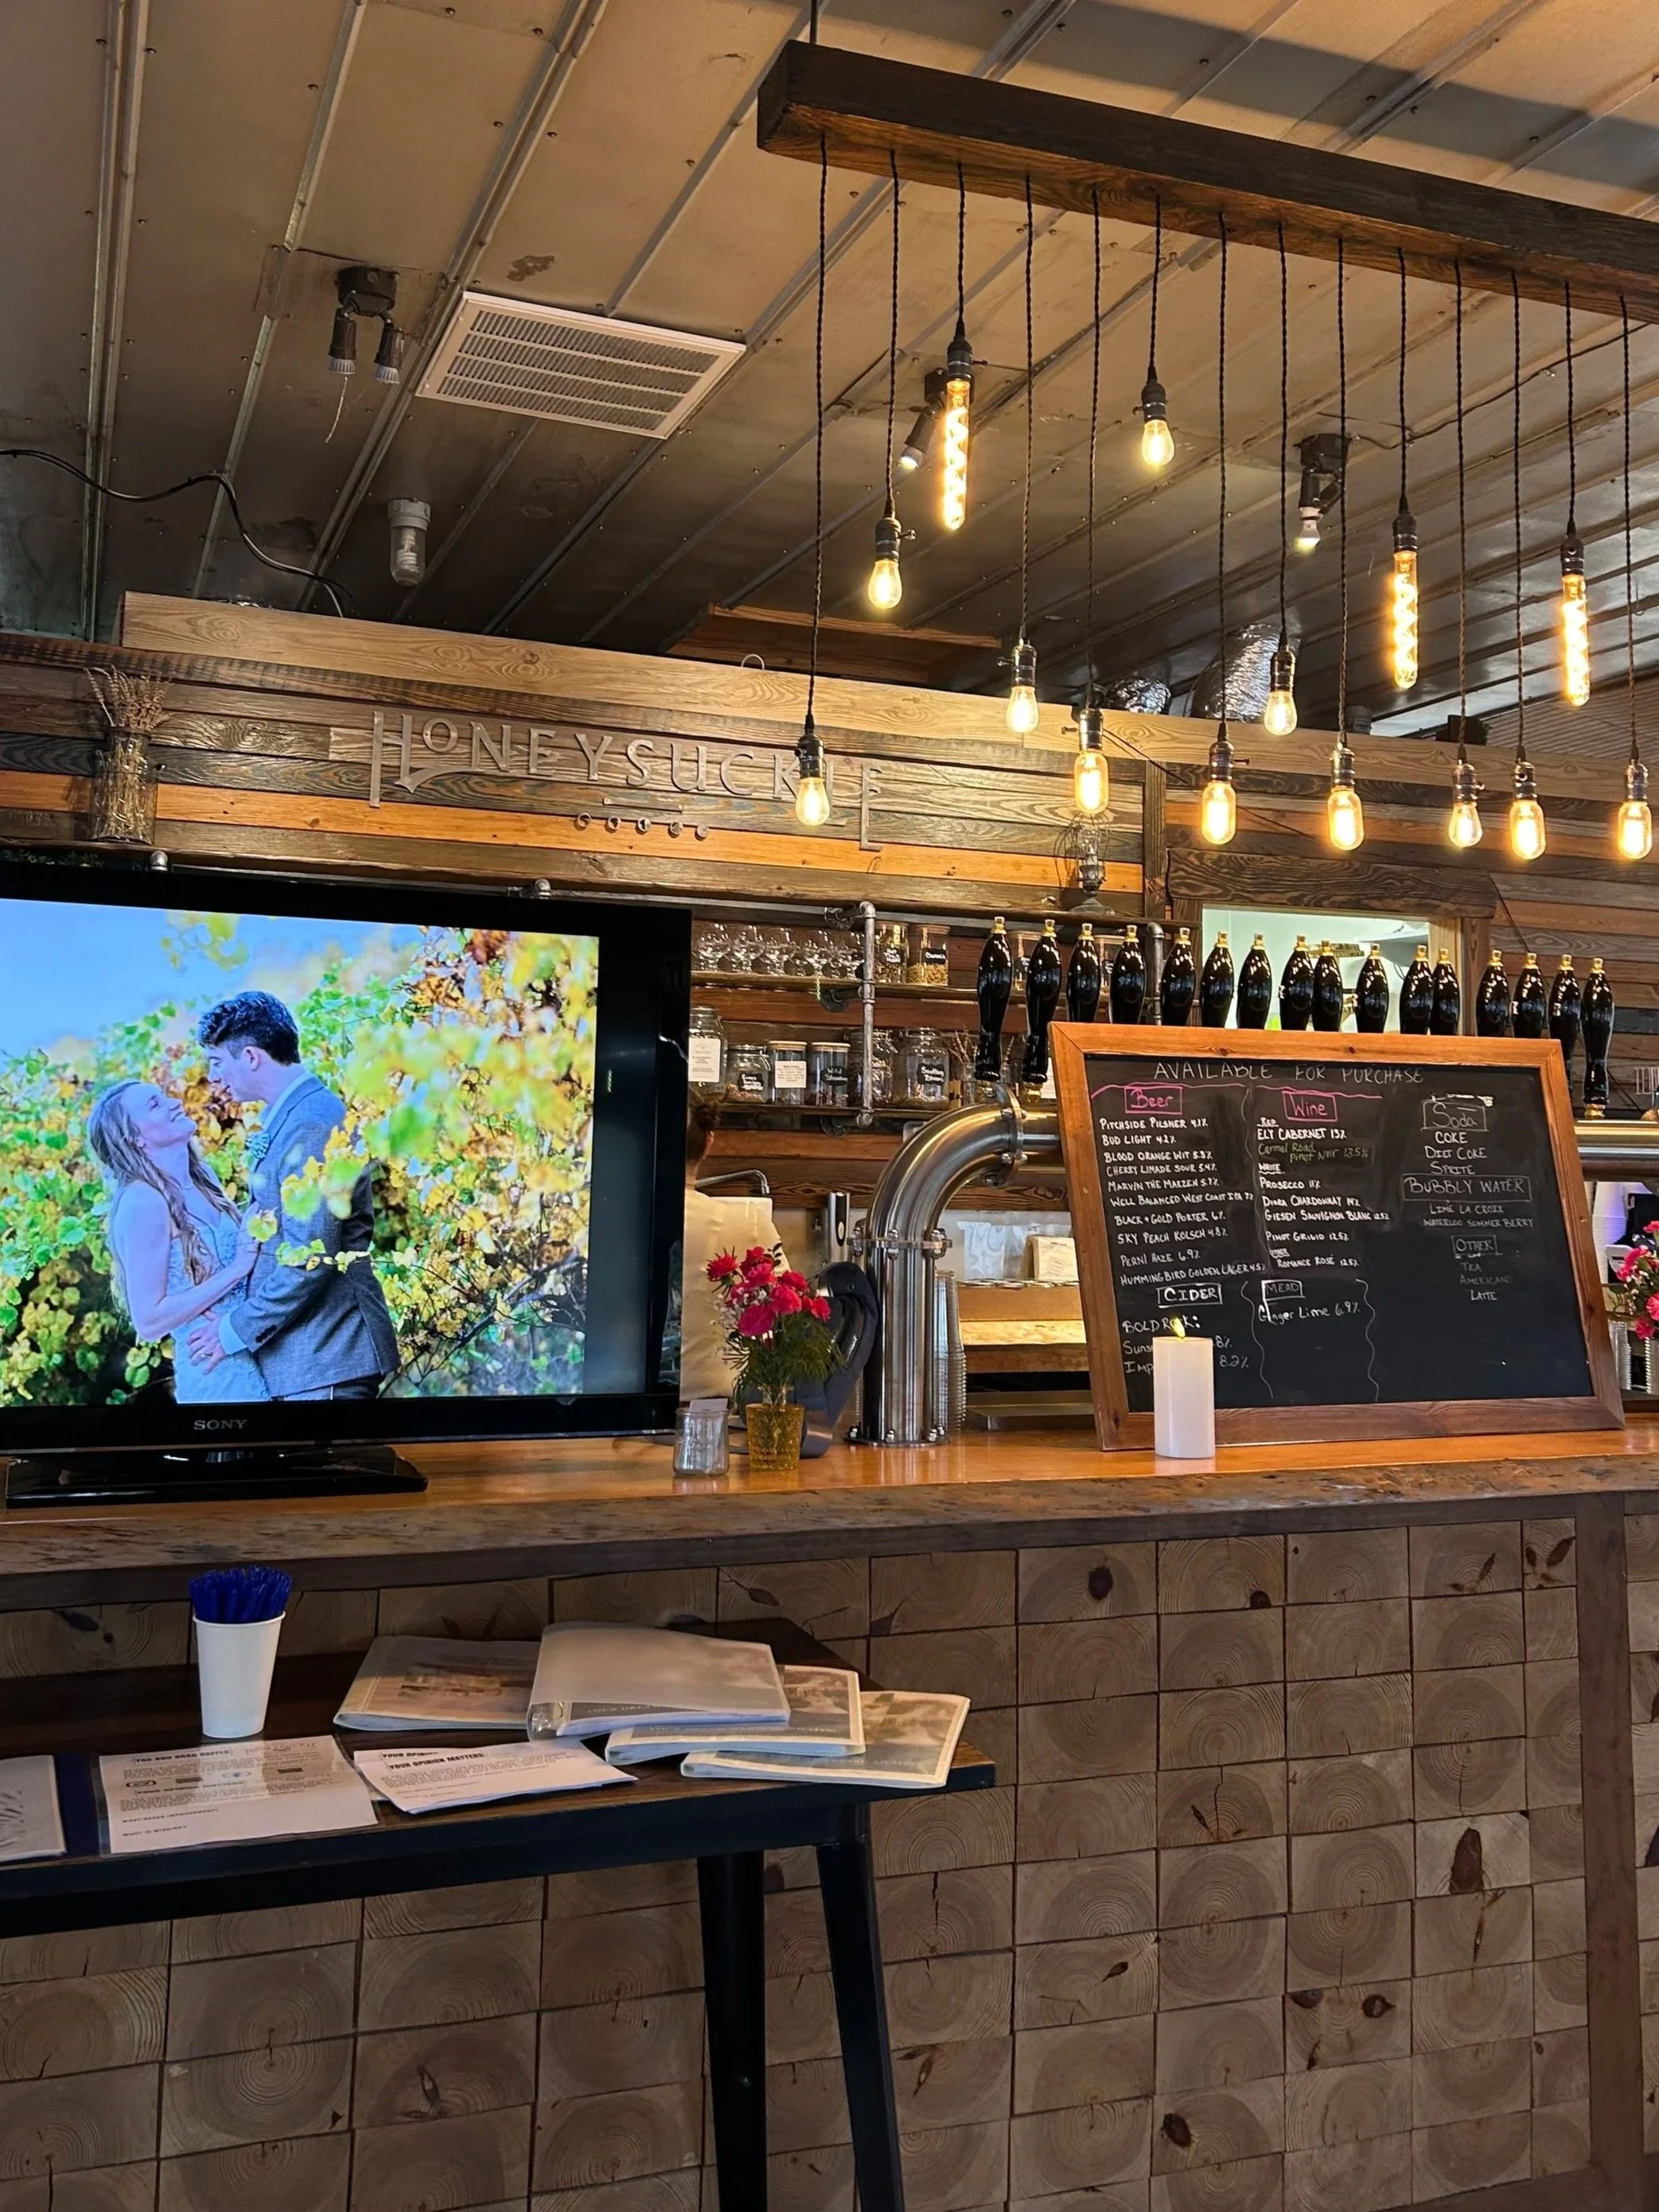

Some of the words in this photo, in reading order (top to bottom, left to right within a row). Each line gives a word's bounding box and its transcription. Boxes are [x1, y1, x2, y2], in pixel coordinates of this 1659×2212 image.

[1154, 1062, 1273, 1081] AVAILABLE
[1295, 1063, 1326, 1081] FOR
[1342, 1066, 1425, 1085] PURCHASE
[1130, 1087, 1174, 1108] Beer
[1289, 1093, 1328, 1117] Wine
[1432, 1101, 1478, 1128] Soda
[1099, 1117, 1147, 1130] PITCHSIDE
[1149, 1116, 1187, 1129] PILSNER
[1101, 1133, 1121, 1147] BUD
[1124, 1134, 1152, 1146] LIGHT
[1257, 1128, 1274, 1140] ELY
[1278, 1127, 1328, 1140] CABERNET
[1435, 1131, 1469, 1144] COKE
[1291, 1141, 1314, 1154] Road
[1424, 1145, 1453, 1159] DIET
[1456, 1147, 1488, 1160] COKE
[1104, 1151, 1135, 1163] BLOOD
[1137, 1150, 1172, 1162] ORANGE
[1173, 1148, 1191, 1160] WIT
[1106, 1165, 1139, 1177] CHERRY
[1140, 1164, 1172, 1174] LIMADE
[1174, 1164, 1197, 1174] SOUR
[1430, 1161, 1476, 1175] SPRITE
[1108, 1180, 1144, 1193] MARVIN
[1145, 1179, 1162, 1190] THE
[1163, 1178, 1198, 1190] MARZEN
[1259, 1176, 1305, 1190] PROSECCO
[1404, 1176, 1473, 1194] BUBBLY
[1479, 1178, 1525, 1194] WATER
[1110, 1195, 1136, 1208] WELL
[1138, 1194, 1181, 1206] BALANCED
[1182, 1194, 1203, 1204] WEST
[1204, 1192, 1225, 1201] COAST
[1290, 1194, 1342, 1208] CHARDONNAY
[1264, 1209, 1297, 1221] GIESEN
[1301, 1209, 1346, 1221] SAUVIGNON
[1345, 1209, 1372, 1221] BLANC
[1429, 1203, 1455, 1215] LIME
[1459, 1204, 1472, 1215] LA
[1474, 1204, 1505, 1215] CROIX
[1114, 1214, 1143, 1226] BLACK
[1151, 1213, 1173, 1225] GOLD
[1175, 1211, 1209, 1223] PORTER
[1503, 1217, 1534, 1228] BERRY
[1118, 1233, 1139, 1246] SKY
[1143, 1232, 1170, 1244] PEACH
[1174, 1228, 1206, 1242] KOLSCH
[1264, 1231, 1291, 1242] PINOT
[1292, 1230, 1326, 1242] GRIGIO
[1455, 1238, 1495, 1252] OTHER
[1276, 1257, 1312, 1268] ROMANCE
[1460, 1261, 1483, 1273] TEA
[1188, 1266, 1220, 1279] GOLDEN
[1221, 1263, 1250, 1275] LAGER
[1459, 1274, 1513, 1286] AMERICANO
[1163, 1286, 1219, 1302] CIDER
[1265, 1282, 1300, 1295] MEAD
[1470, 1289, 1498, 1301] LATTE
[1298, 1305, 1331, 1320] Lime
[1121, 1318, 1160, 1334] BOLD
[193, 1419, 248, 1431] SONY
[389, 1762, 411, 1770] YOUR
[412, 1758, 446, 1767] OPINION
[446, 1752, 485, 1762] MATTERS
